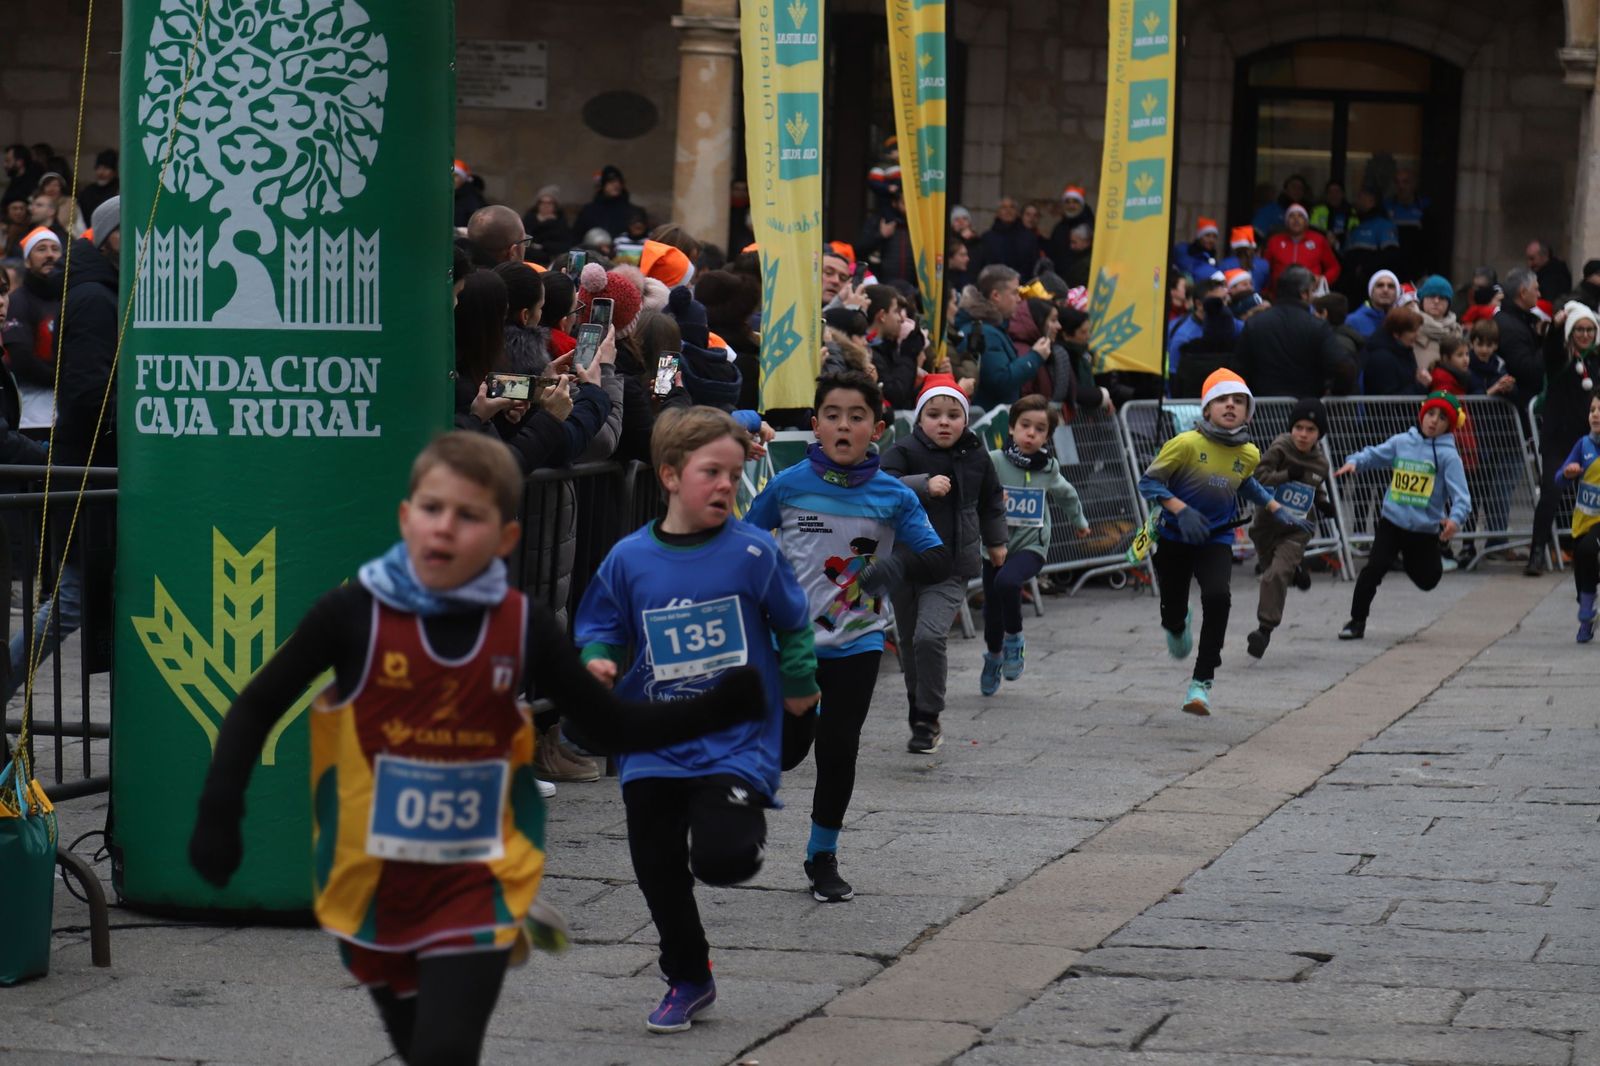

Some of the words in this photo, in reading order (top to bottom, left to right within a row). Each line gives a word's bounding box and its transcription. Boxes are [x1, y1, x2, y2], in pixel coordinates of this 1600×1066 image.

[135, 355, 381, 394] FUNDACION
[135, 397, 219, 438] CAJA
[229, 398, 382, 437] RURAL
[1282, 489, 1309, 508] 052
[1395, 472, 1429, 493] 0927
[1007, 497, 1037, 514] 040
[664, 619, 726, 655] 135
[395, 788, 482, 830] 053
